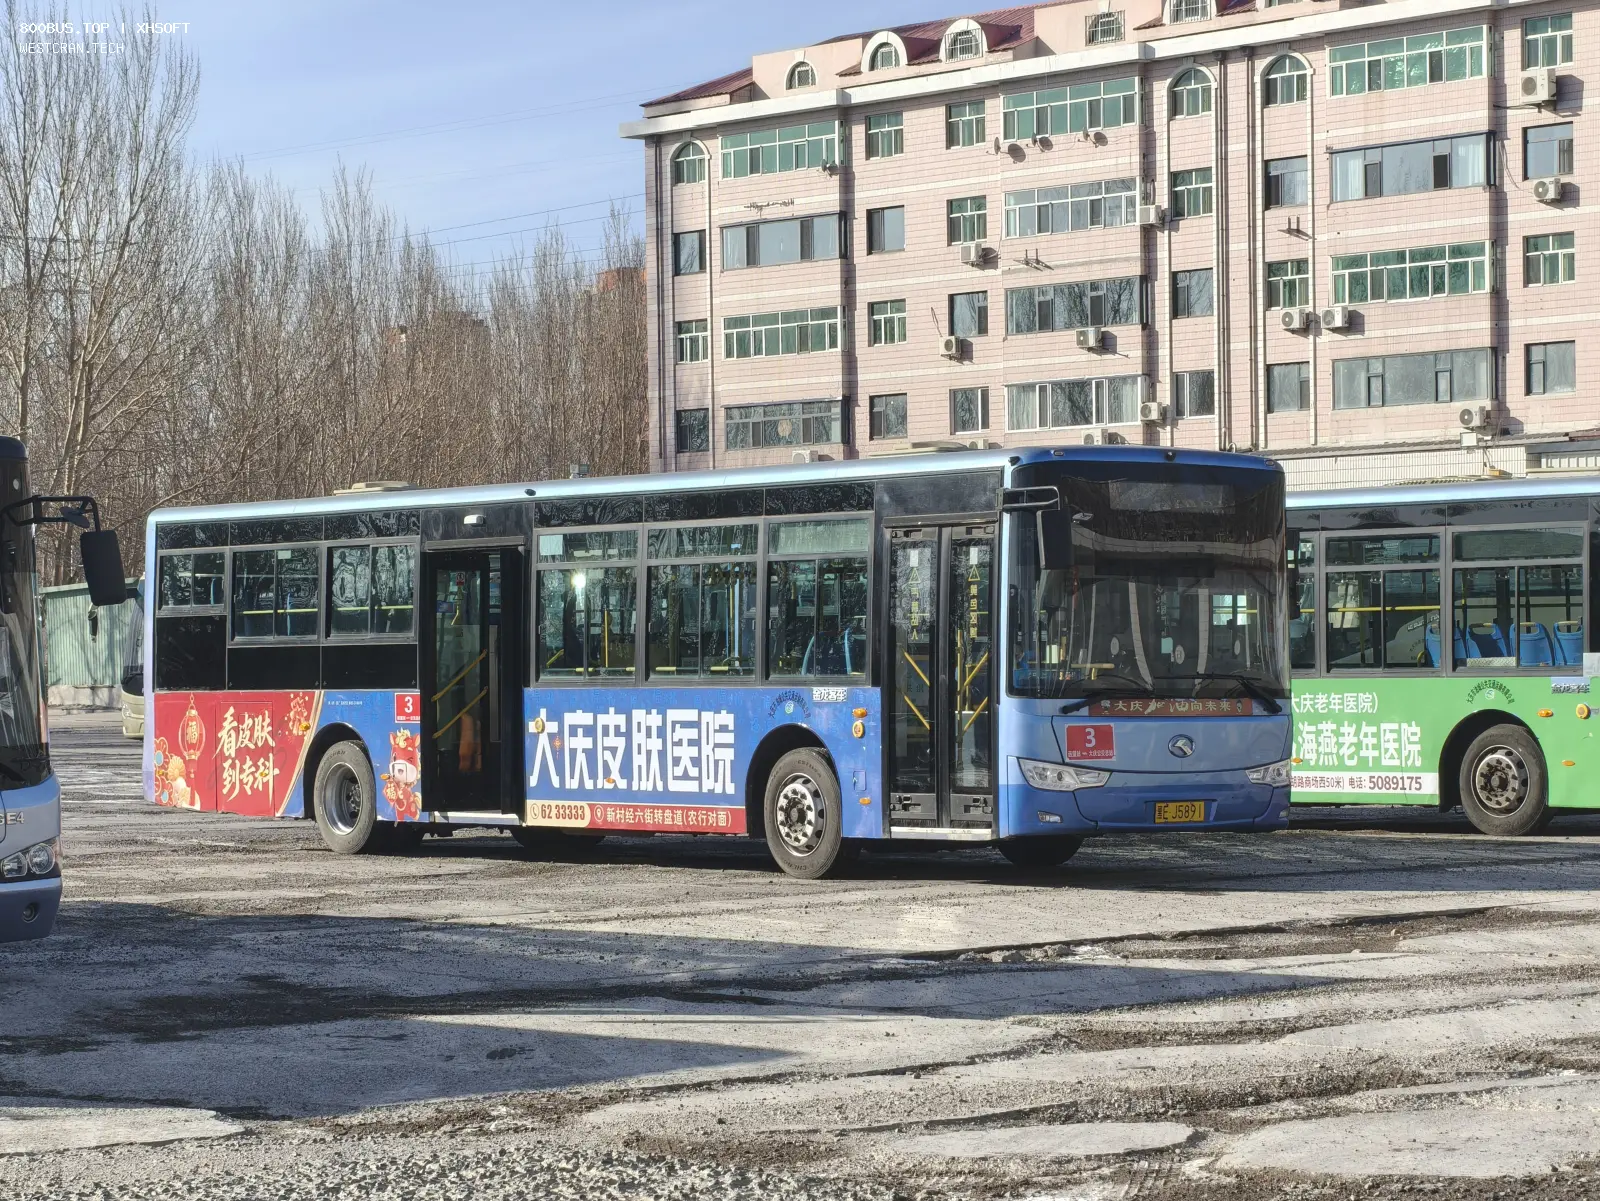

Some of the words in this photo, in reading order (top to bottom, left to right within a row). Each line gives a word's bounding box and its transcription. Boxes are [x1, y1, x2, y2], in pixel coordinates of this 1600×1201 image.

[404, 695, 414, 714] 3
[812, 688, 847, 702] 金龙客车
[1114, 698, 1232, 715] 大庆加油向未来
[185, 721, 198, 744] 福
[212, 706, 276, 760] 看皮肤
[1085, 727, 1096, 748] 3
[528, 707, 735, 794] 大庆皮肤医院
[1291, 721, 1422, 768] 海燕老年医院
[222, 752, 280, 811] 到专科
[605, 806, 732, 828] 新村经六街转盘道(农行对面)
